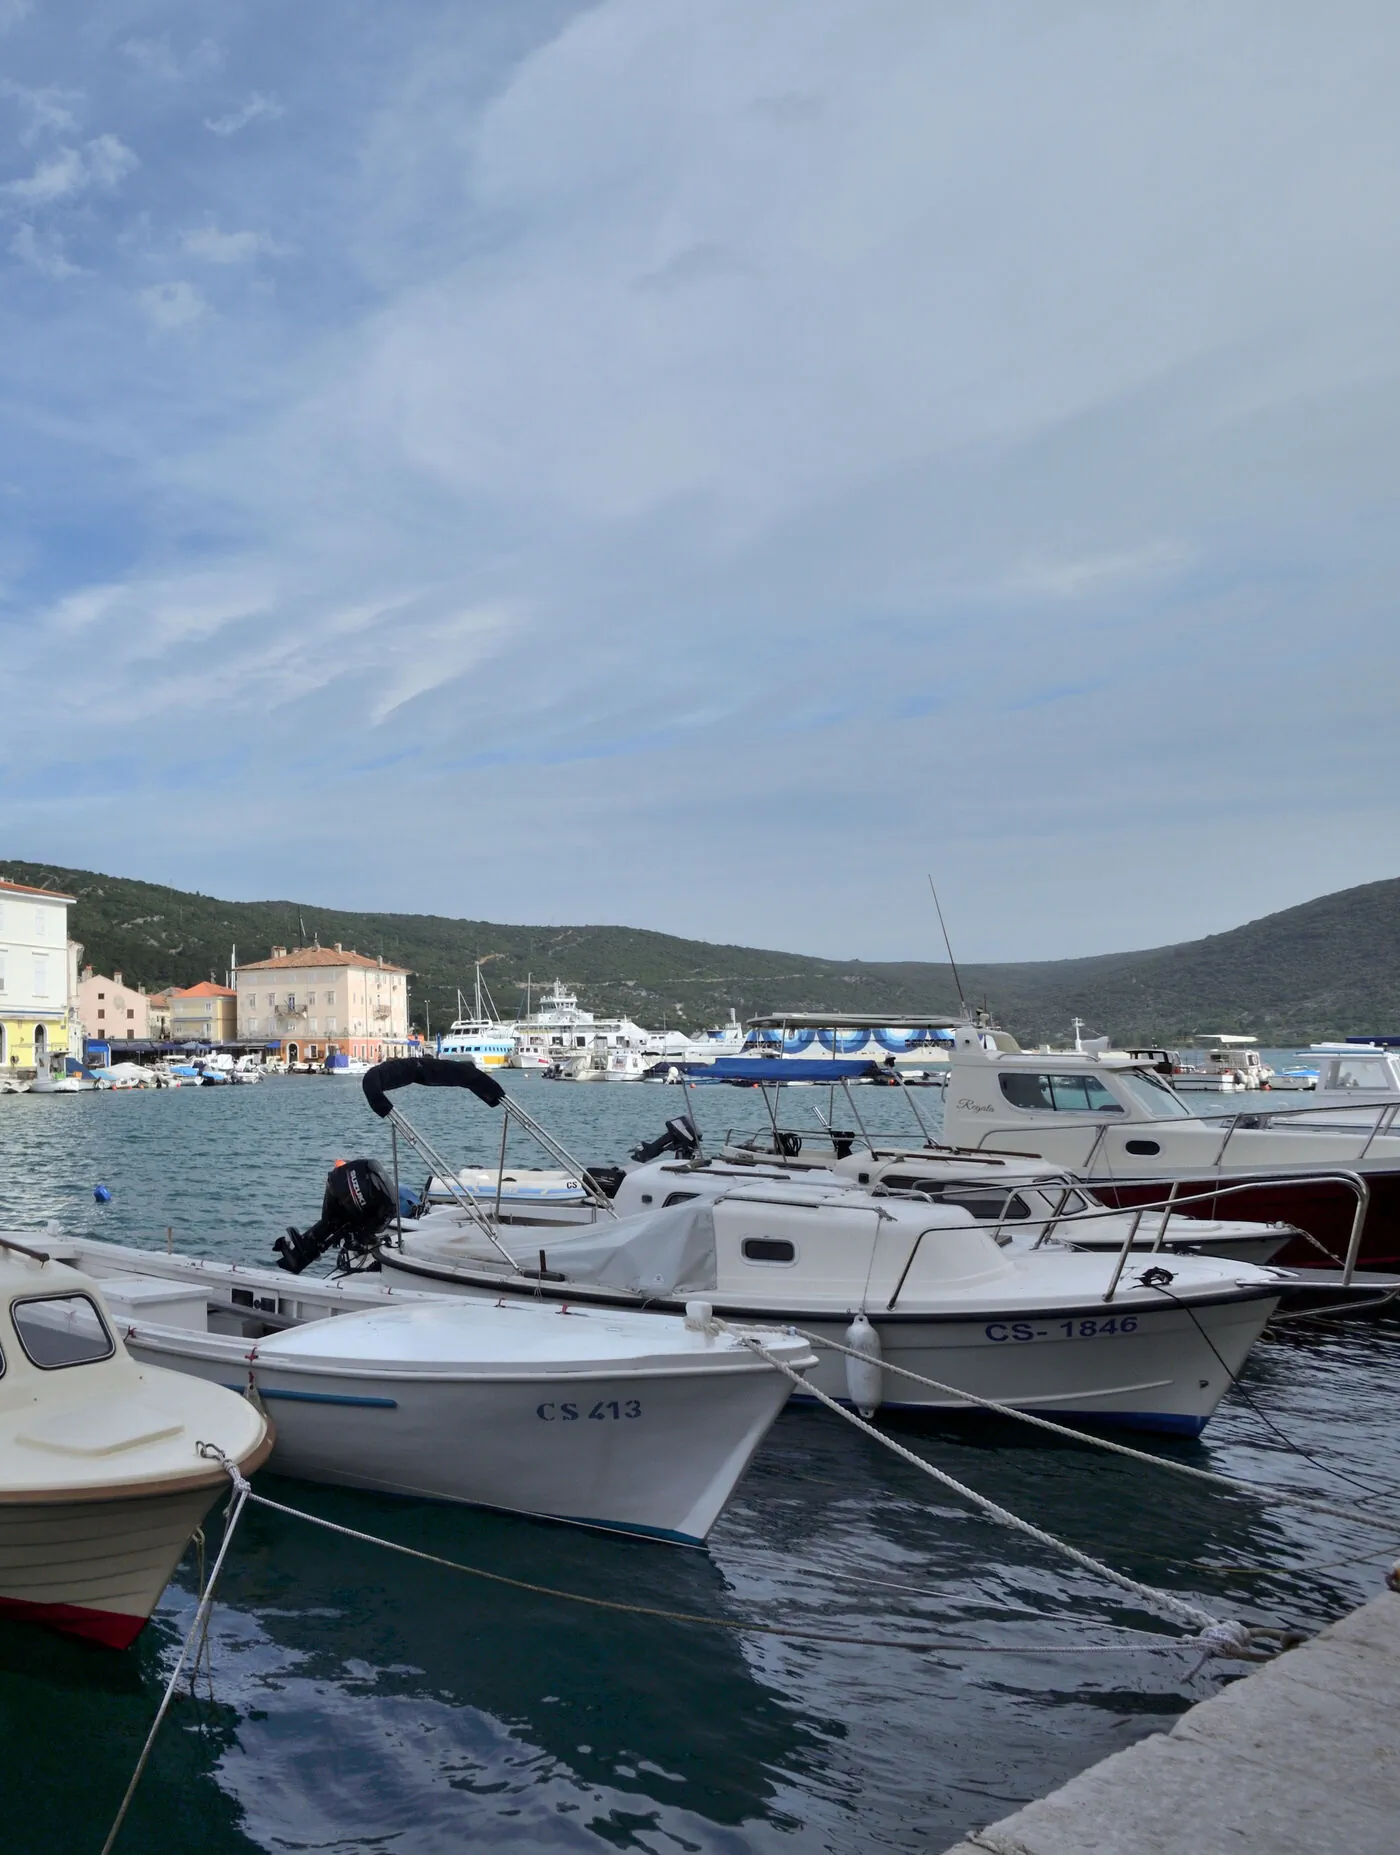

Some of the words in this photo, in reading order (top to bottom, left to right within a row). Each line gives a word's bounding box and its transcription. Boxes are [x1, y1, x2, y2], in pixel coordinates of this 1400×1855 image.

[350, 1169, 367, 1207] SUZUKI
[566, 1181, 578, 1190] CS
[1059, 1316, 1139, 1338] 1846
[536, 1402, 580, 1421] CS
[588, 1400, 642, 1420] 413
